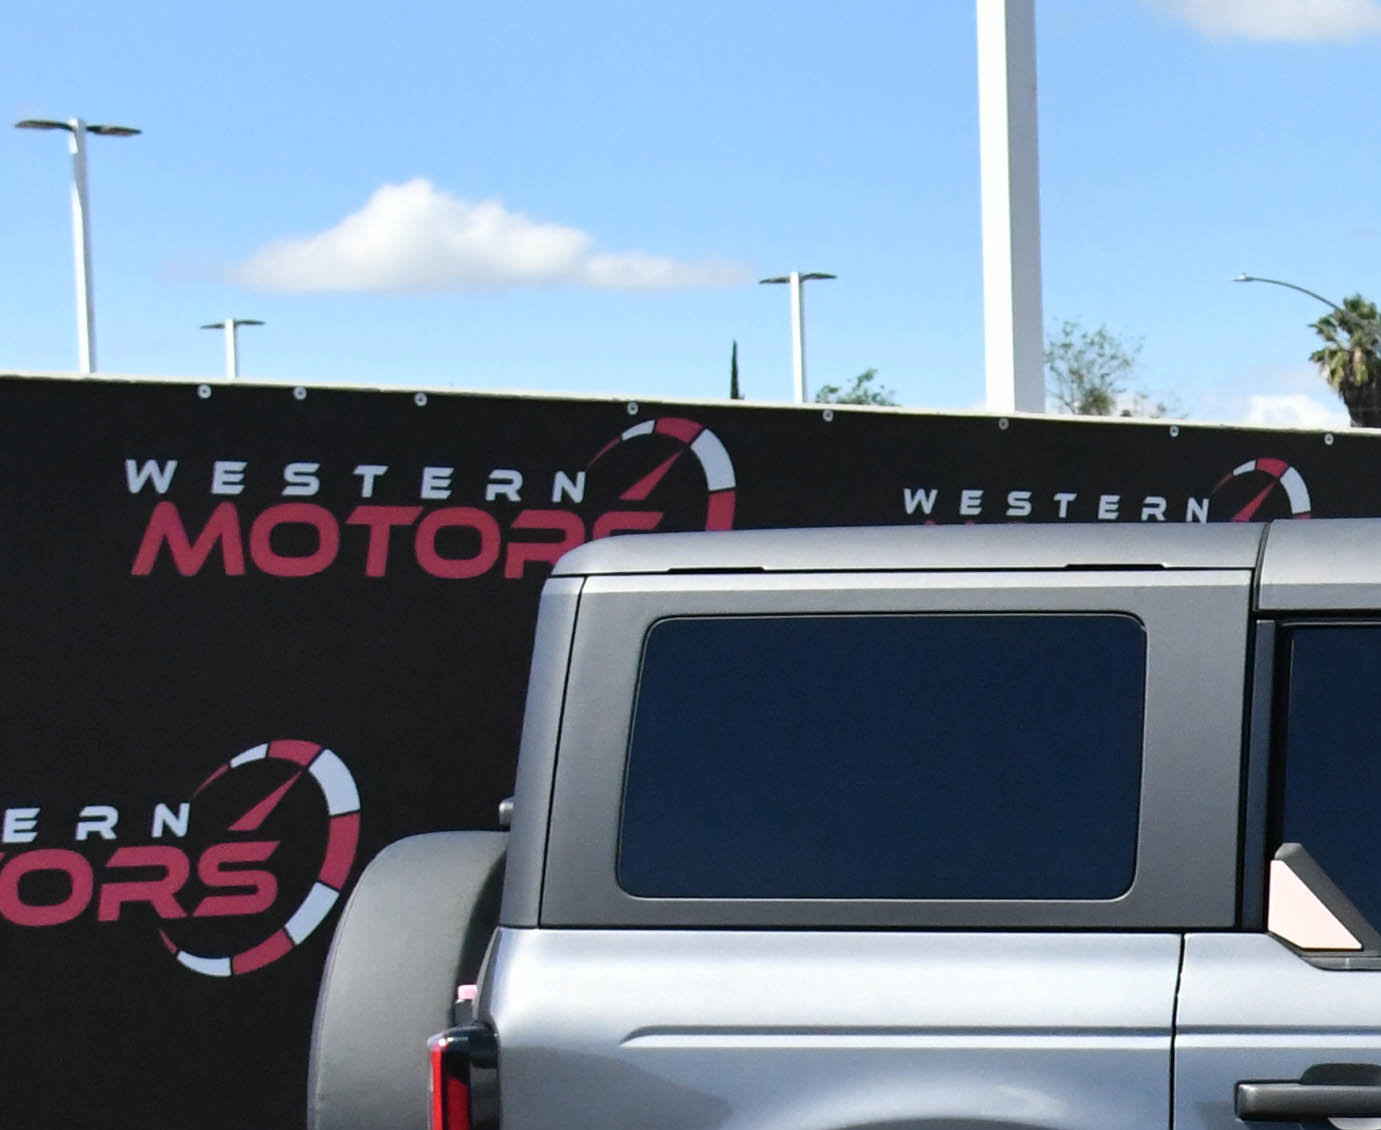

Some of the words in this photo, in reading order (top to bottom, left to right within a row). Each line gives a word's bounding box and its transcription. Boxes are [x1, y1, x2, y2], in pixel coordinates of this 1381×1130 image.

[125, 459, 587, 503] WESTERN
[903, 487, 1210, 524] WESTERN
[2, 802, 190, 843] ERN
[0, 840, 281, 927] ORS
